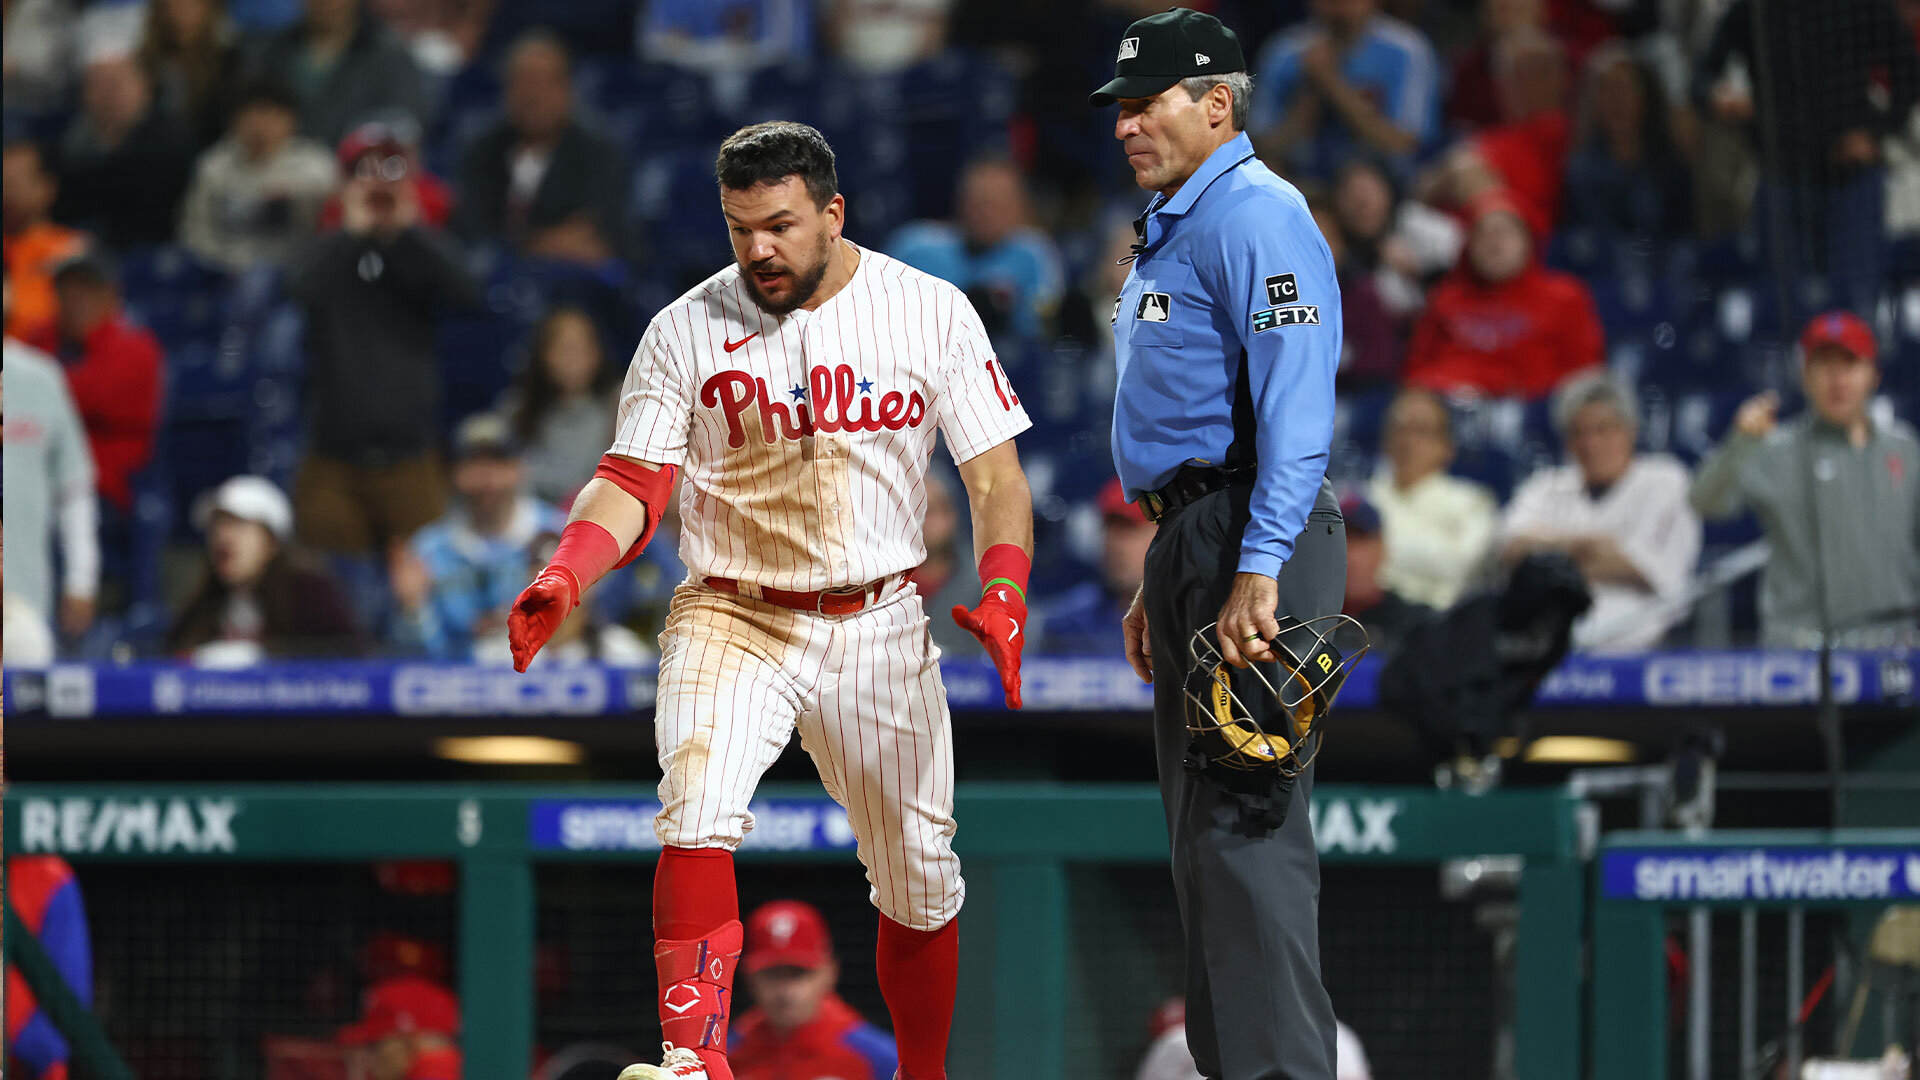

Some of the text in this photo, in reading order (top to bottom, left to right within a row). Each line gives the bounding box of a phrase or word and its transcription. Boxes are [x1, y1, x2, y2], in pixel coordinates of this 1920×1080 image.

[1268, 281, 1295, 298] TC
[1275, 307, 1319, 325] FTX
[700, 364, 925, 448] Phillies
[393, 667, 607, 715] GEICO
[1021, 660, 1154, 709] GEI
[1644, 656, 1861, 706] GEICO
[20, 798, 238, 852] RE/MAX
[1634, 851, 1897, 900] smartwater
